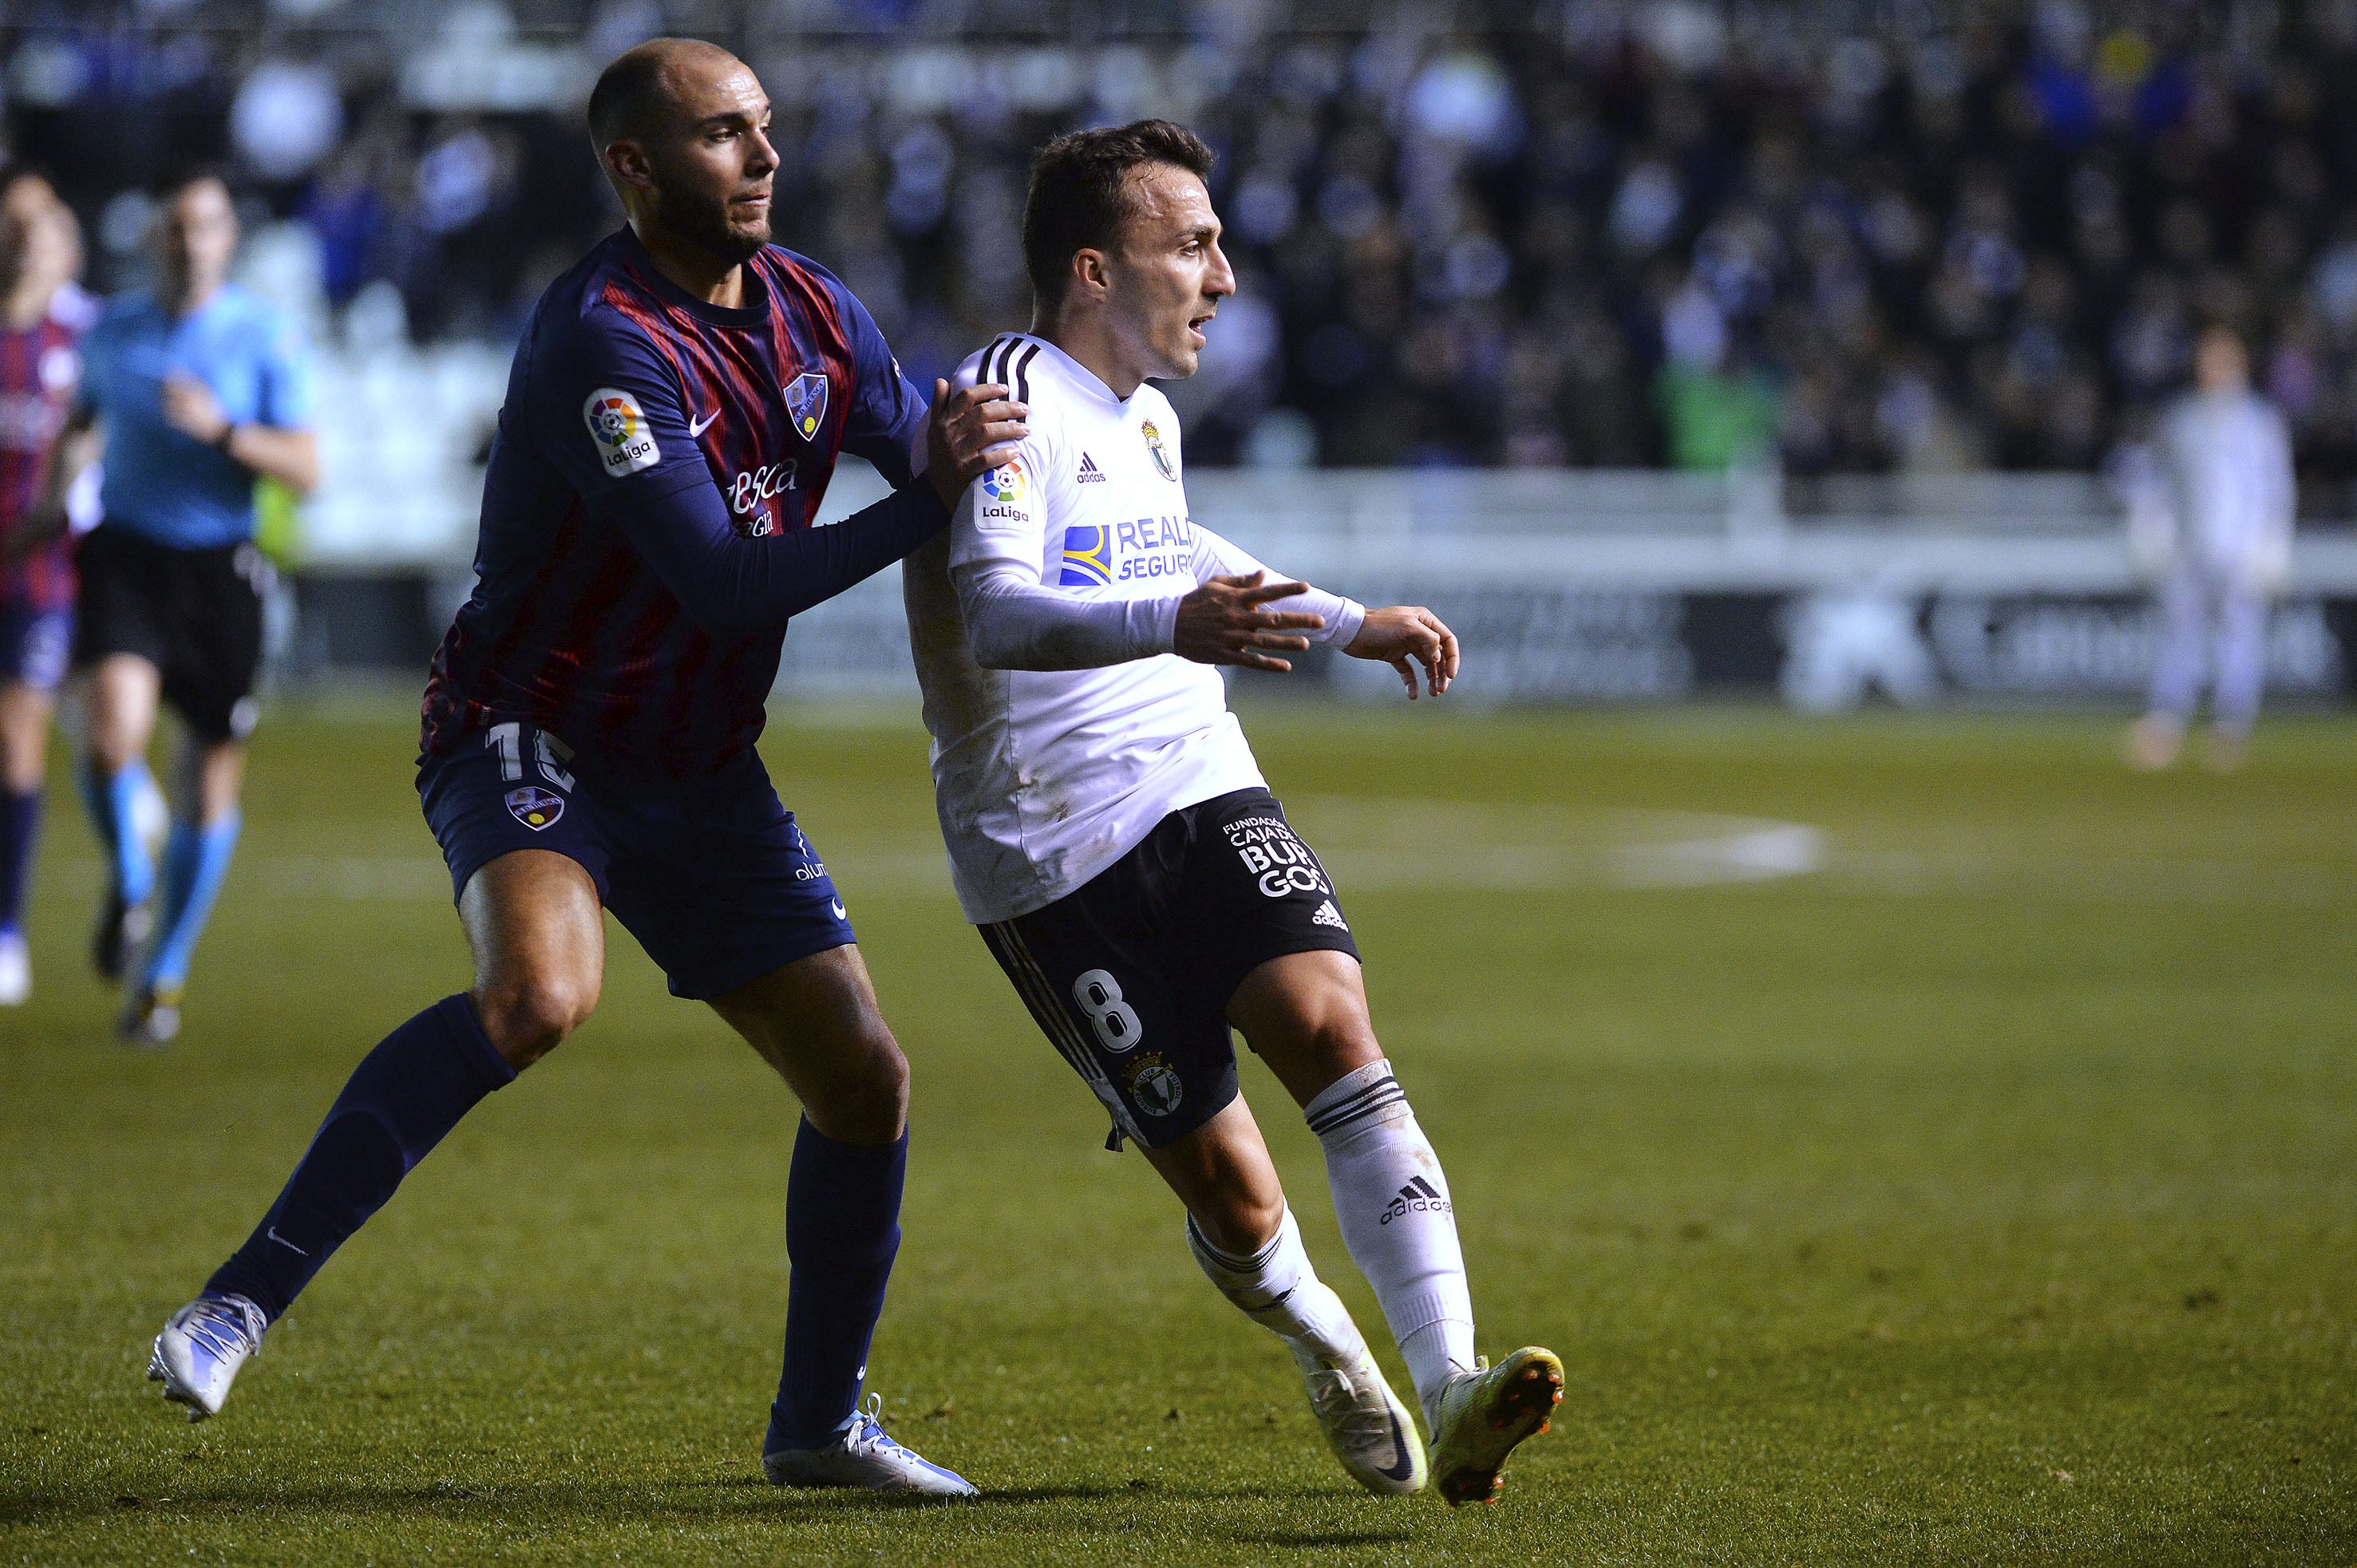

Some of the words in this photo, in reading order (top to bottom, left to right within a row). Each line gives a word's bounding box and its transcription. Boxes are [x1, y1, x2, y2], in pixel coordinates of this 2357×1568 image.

[607, 441, 651, 467] LaLiga
[983, 505, 1029, 523] LaLiga
[1117, 515, 1191, 554] REAL
[1230, 827, 1279, 847] CAJA
[1259, 865, 1330, 898] GOS
[1071, 968, 1143, 1055] 8
[1138, 1068, 1155, 1081] CLUB
[1379, 1198, 1451, 1226] adidas
